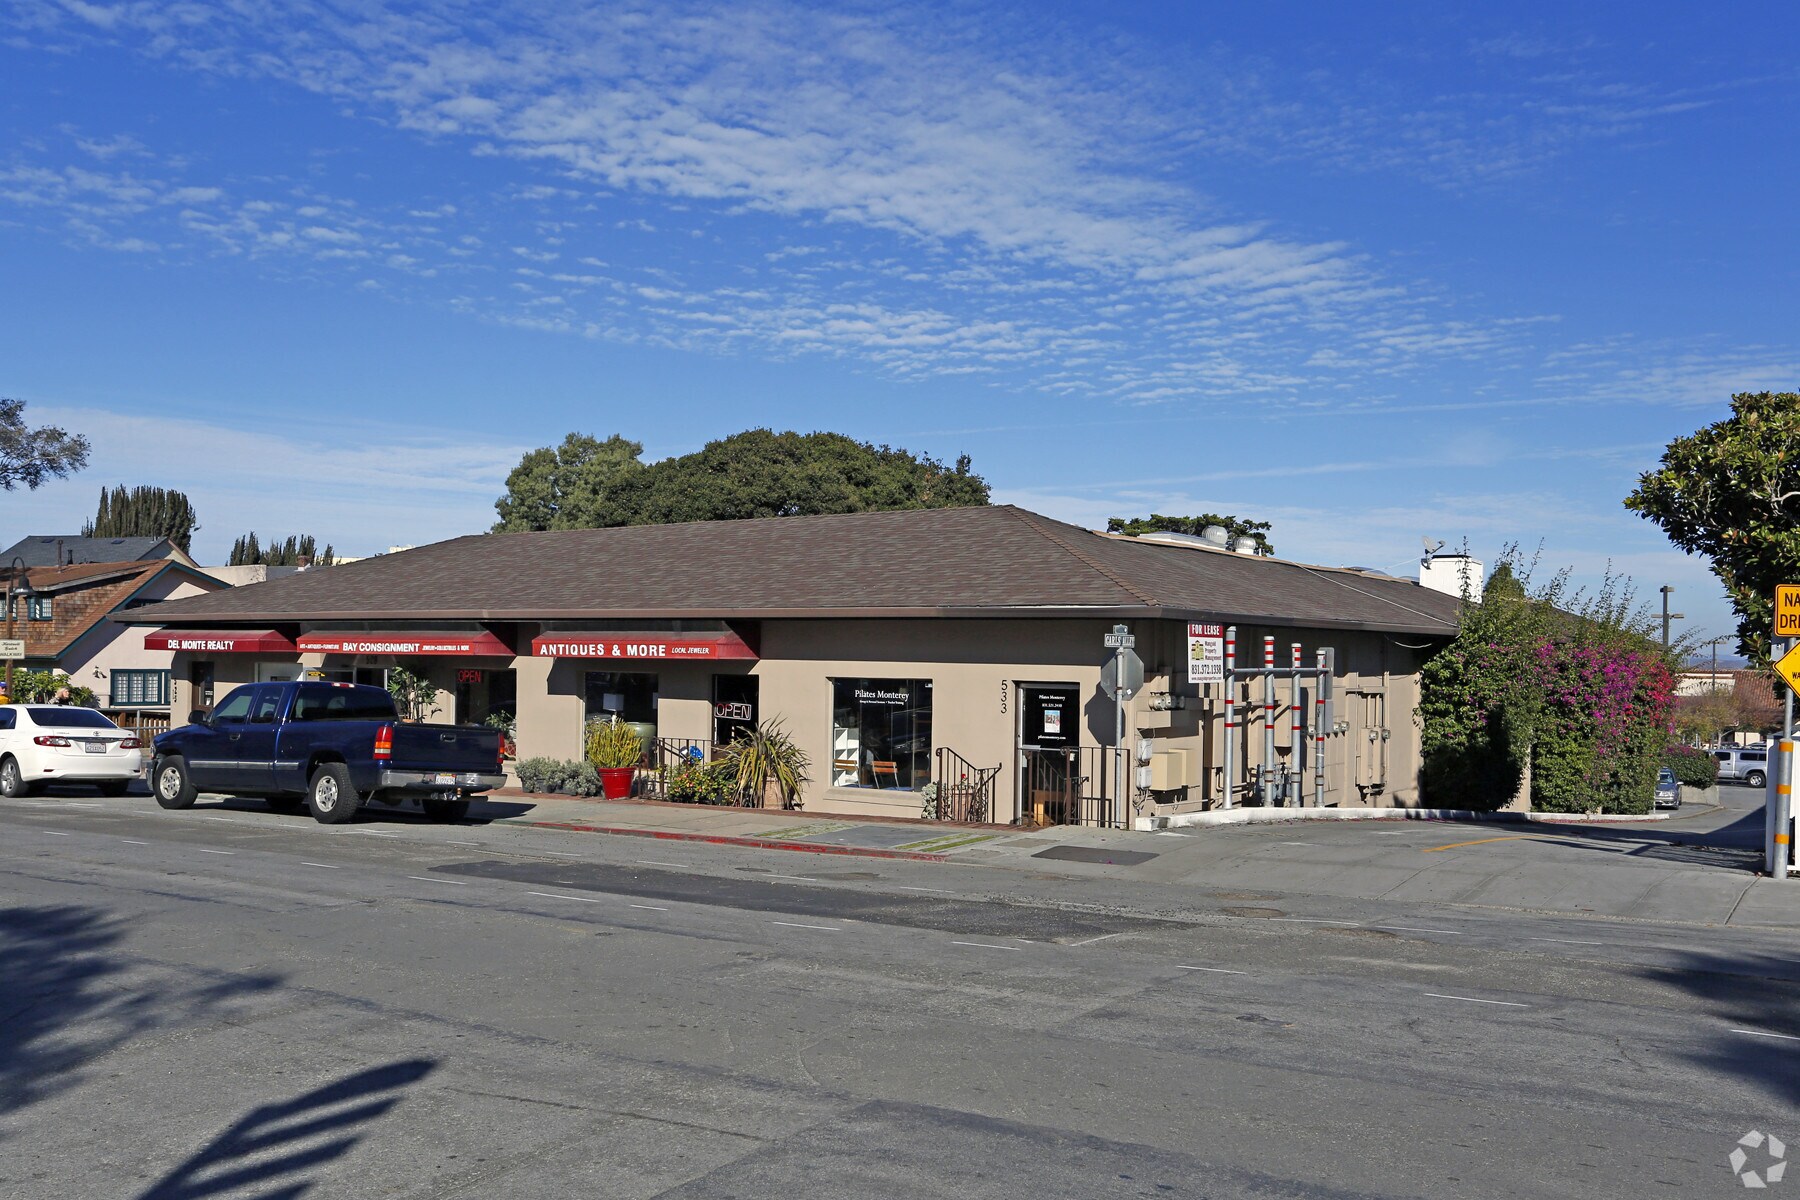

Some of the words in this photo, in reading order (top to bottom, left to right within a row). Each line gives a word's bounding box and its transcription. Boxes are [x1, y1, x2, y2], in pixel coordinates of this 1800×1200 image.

[1191, 624, 1203, 634] FOR
[1204, 625, 1220, 635] LEASE
[167, 640, 180, 649] DEL
[181, 640, 206, 650] MONTE
[207, 641, 234, 650] REALTY
[342, 642, 358, 652] BAY
[359, 643, 420, 652] CONSIGNMENT
[540, 643, 605, 656] ANTIQUES
[611, 644, 621, 656] &
[626, 644, 666, 657] MORE
[687, 647, 710, 655] JEWELER
[458, 670, 481, 683] OPEN
[854, 689, 876, 698] Pilates
[877, 690, 909, 702] Monterey
[716, 703, 750, 719] OPEN
